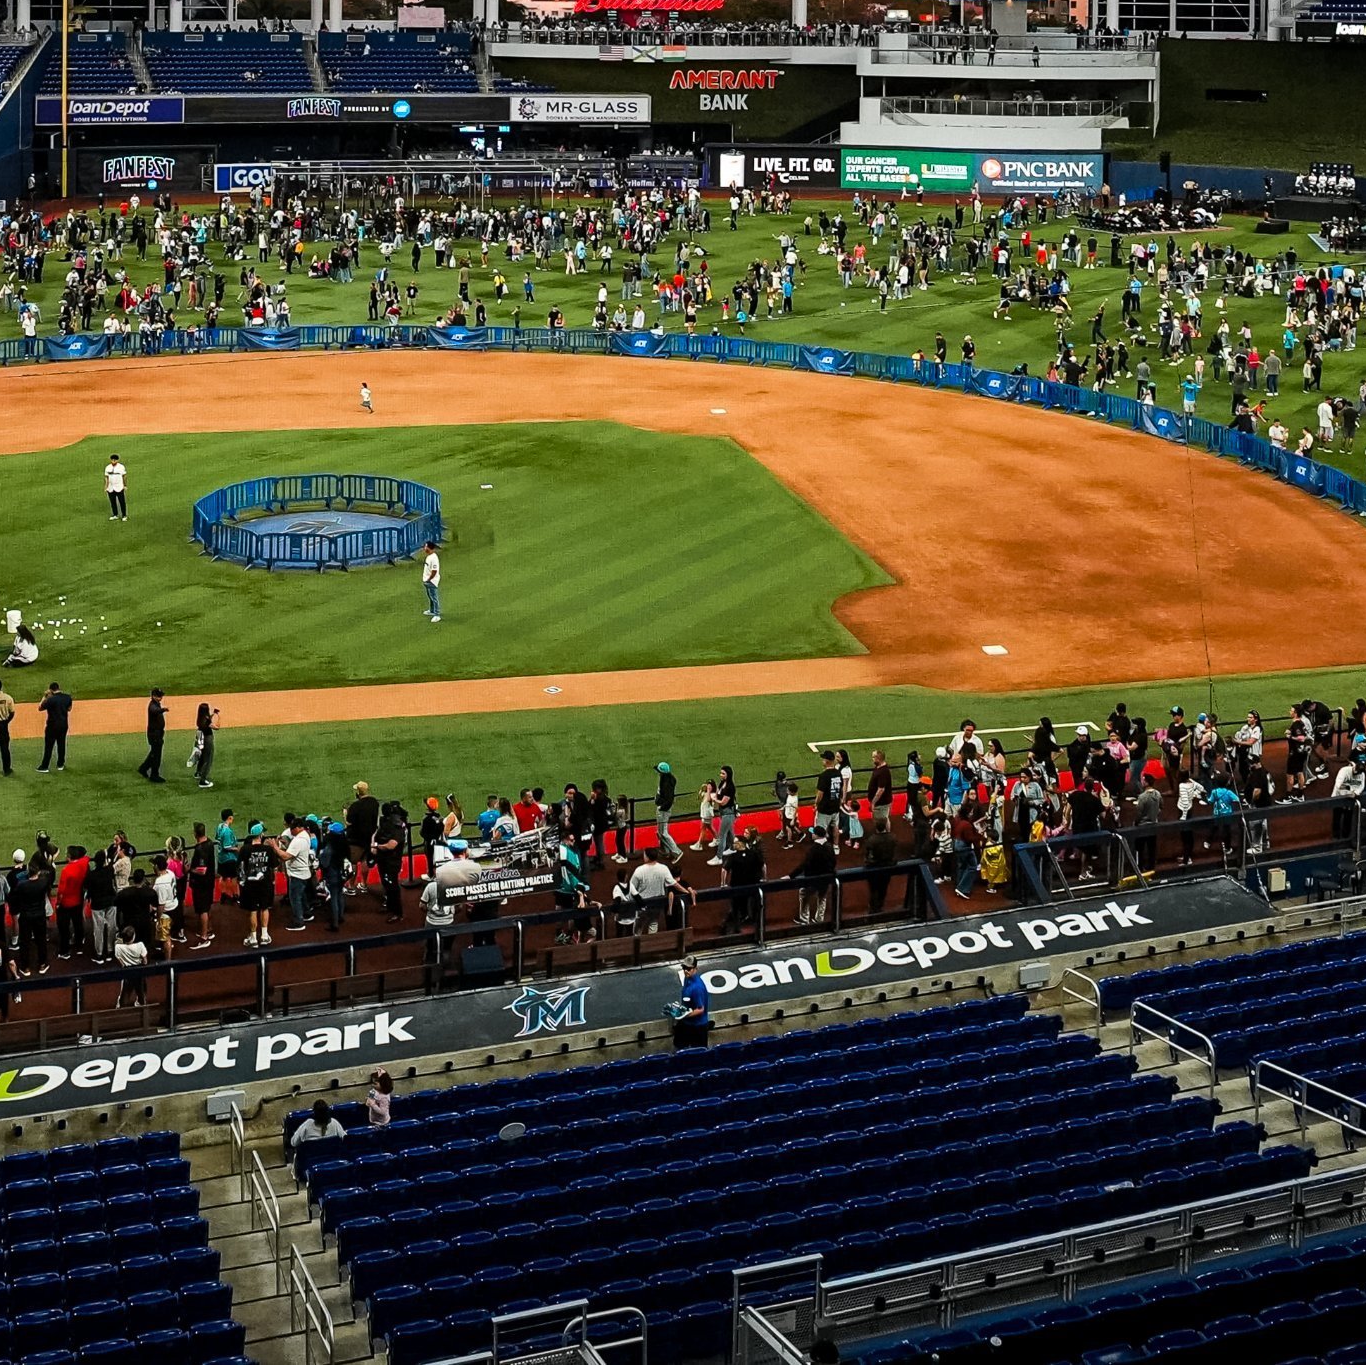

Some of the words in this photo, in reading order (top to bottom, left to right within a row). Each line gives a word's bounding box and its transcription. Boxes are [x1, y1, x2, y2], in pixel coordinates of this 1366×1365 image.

[669, 70, 779, 89] AMERANT
[68, 100, 151, 116] loanDepot
[287, 98, 341, 118] FANFEST
[546, 101, 638, 113] MR-GLASS
[699, 94, 748, 111] BANK
[103, 156, 175, 183] FANFEST
[753, 158, 785, 172] LIVE.
[789, 158, 810, 172] FIT.
[813, 158, 835, 172] GO.
[846, 157, 864, 165] OUR
[865, 157, 897, 166] CANCER
[846, 165, 882, 173] EXPERTS
[884, 166, 910, 174] COVER
[846, 174, 860, 182] ALL
[861, 174, 878, 182] THE
[479, 868, 521, 883] Marlins
[445, 886, 466, 898] SCORE
[466, 883, 488, 895] PASSES
[488, 882, 500, 892] FOR
[500, 878, 525, 890] BATTING
[526, 874, 554, 886] PRACTICE
[679, 920, 1013, 994] oanDepot
[1018, 901, 1154, 950] park
[254, 1012, 417, 1072] park
